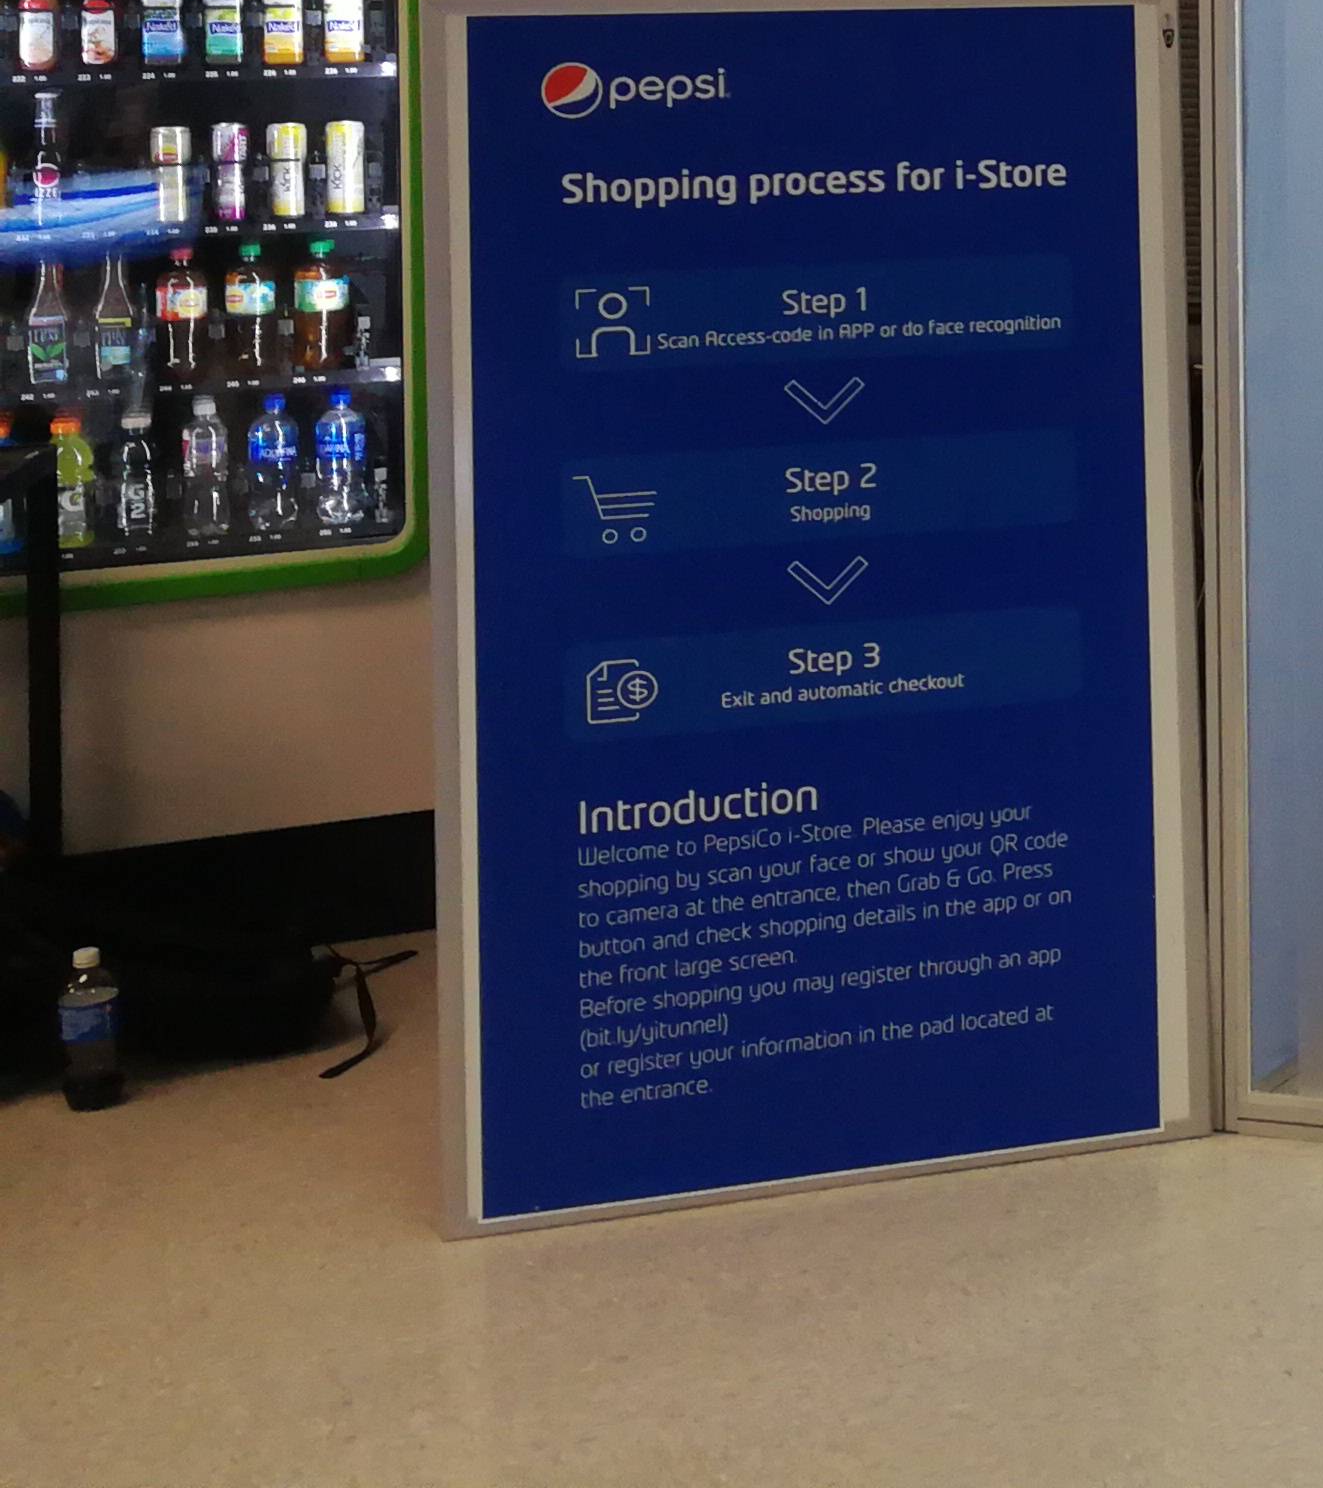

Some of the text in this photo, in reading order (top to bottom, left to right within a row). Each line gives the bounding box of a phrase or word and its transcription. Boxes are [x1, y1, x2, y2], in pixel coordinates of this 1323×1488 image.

[609, 67, 729, 109] pepsi
[561, 159, 1068, 209] Shopping process for i-Store
[782, 287, 868, 318] Step 1
[658, 314, 1061, 350] Scan Access-code in APP or do face recognition
[785, 463, 877, 496] Step 2
[790, 502, 871, 524] Shopping
[788, 642, 881, 676] Step 3
[721, 672, 965, 710] Exit and automatic checkout
[579, 781, 818, 834] Introduction
[578, 843, 669, 867] Welcome
[676, 840, 696, 858] to
[704, 830, 781, 857] PepsiCo
[863, 814, 925, 836] Please
[932, 810, 984, 833] enjoy
[990, 804, 1031, 827] your
[578, 831, 1068, 900] shopping by scan your face or show your QR code
[579, 910, 599, 929] to
[606, 905, 678, 926] camera
[686, 901, 705, 918] at
[712, 895, 745, 916] the
[752, 885, 841, 911] entrance,
[848, 880, 891, 901] then
[897, 872, 941, 895] Grab
[947, 869, 960, 888] &
[1003, 862, 1053, 883] Press
[579, 888, 1072, 959] button and check shopping details in the app or on
[579, 948, 798, 989] the front large screen.
[580, 946, 1062, 1019] Before shopping you may register through an app
[580, 1012, 729, 1052] (bit.ly/yitunnel)
[580, 1004, 1054, 1080] or register your information in the pad located at
[581, 1076, 712, 1109] the entrance.
